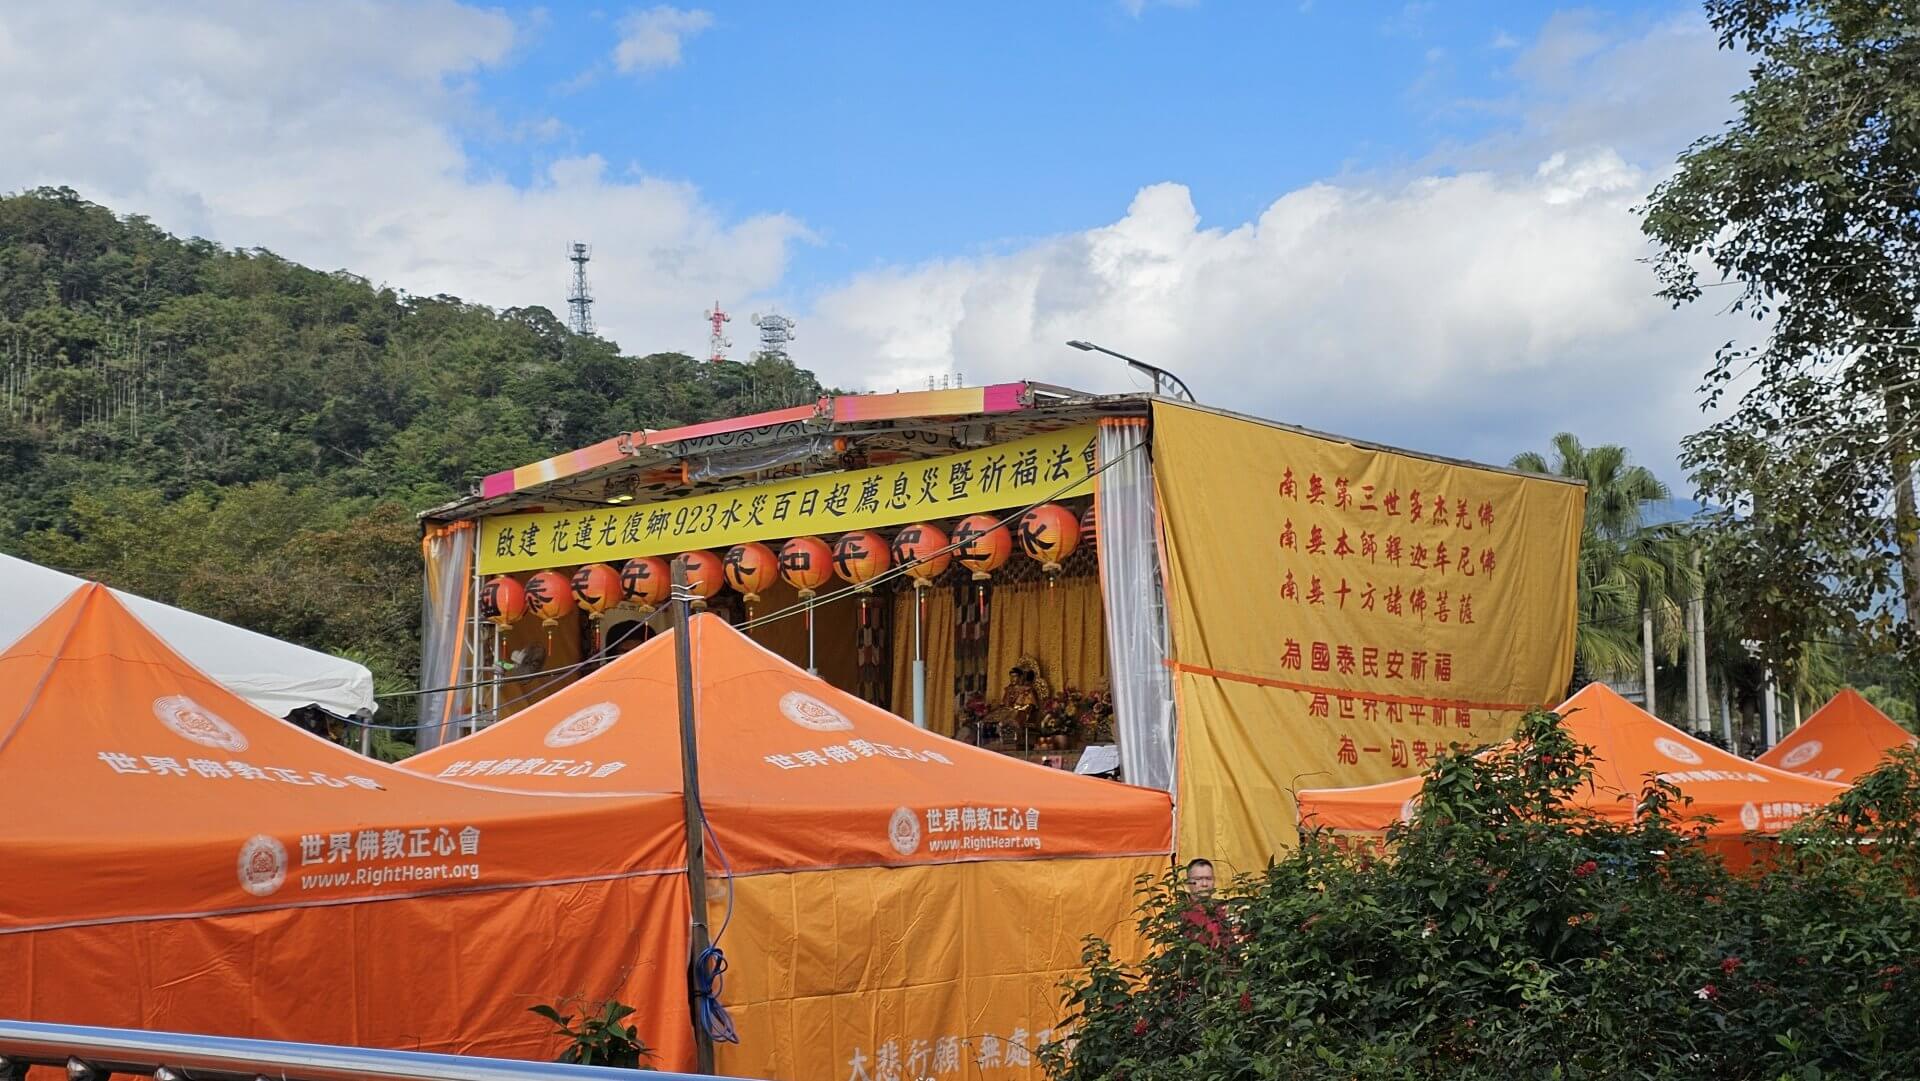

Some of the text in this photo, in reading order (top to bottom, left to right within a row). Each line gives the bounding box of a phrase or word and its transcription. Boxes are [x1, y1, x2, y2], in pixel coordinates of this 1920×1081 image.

[1279, 466, 1496, 534] 南無第三世多杰羌佛
[1279, 517, 1497, 581] 南無本師釋迦牟尼佛
[1280, 568, 1475, 624] 南無十方諸佛菩薩
[1280, 638, 1453, 682] 為國泰民安祈福
[926, 807, 1041, 834] 世界佛教正心會
[300, 825, 481, 866] 世界佛教正心會
[929, 836, 1041, 852] www.RightHeart.org
[301, 863, 480, 890] www.RightHeart.org
